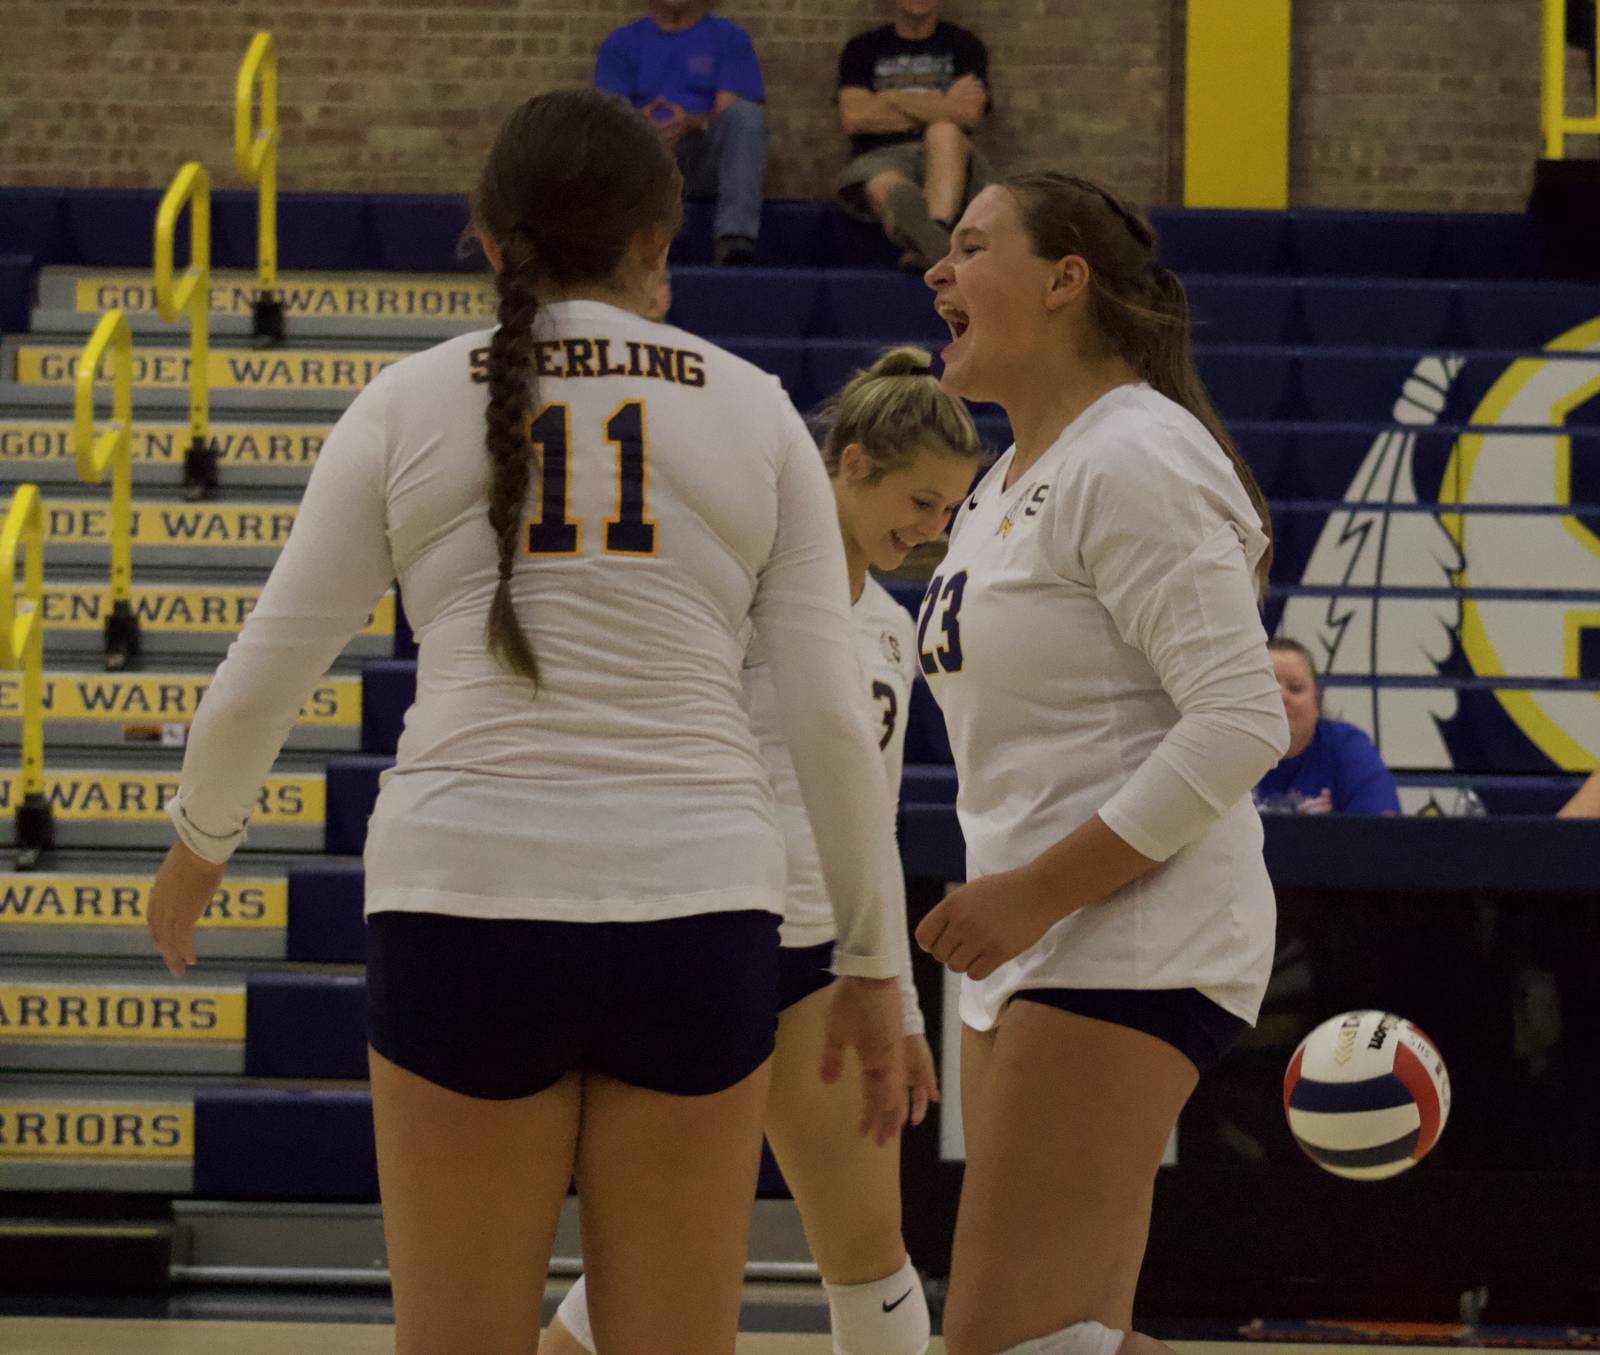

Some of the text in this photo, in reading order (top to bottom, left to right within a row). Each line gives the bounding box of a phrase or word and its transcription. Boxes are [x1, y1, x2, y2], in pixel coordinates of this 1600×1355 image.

[229, 357, 392, 385] WARRI
[469, 337, 706, 387] SERLING
[524, 399, 660, 558] 11
[917, 567, 968, 677] 23
[0, 1113, 181, 1147] RIORS
